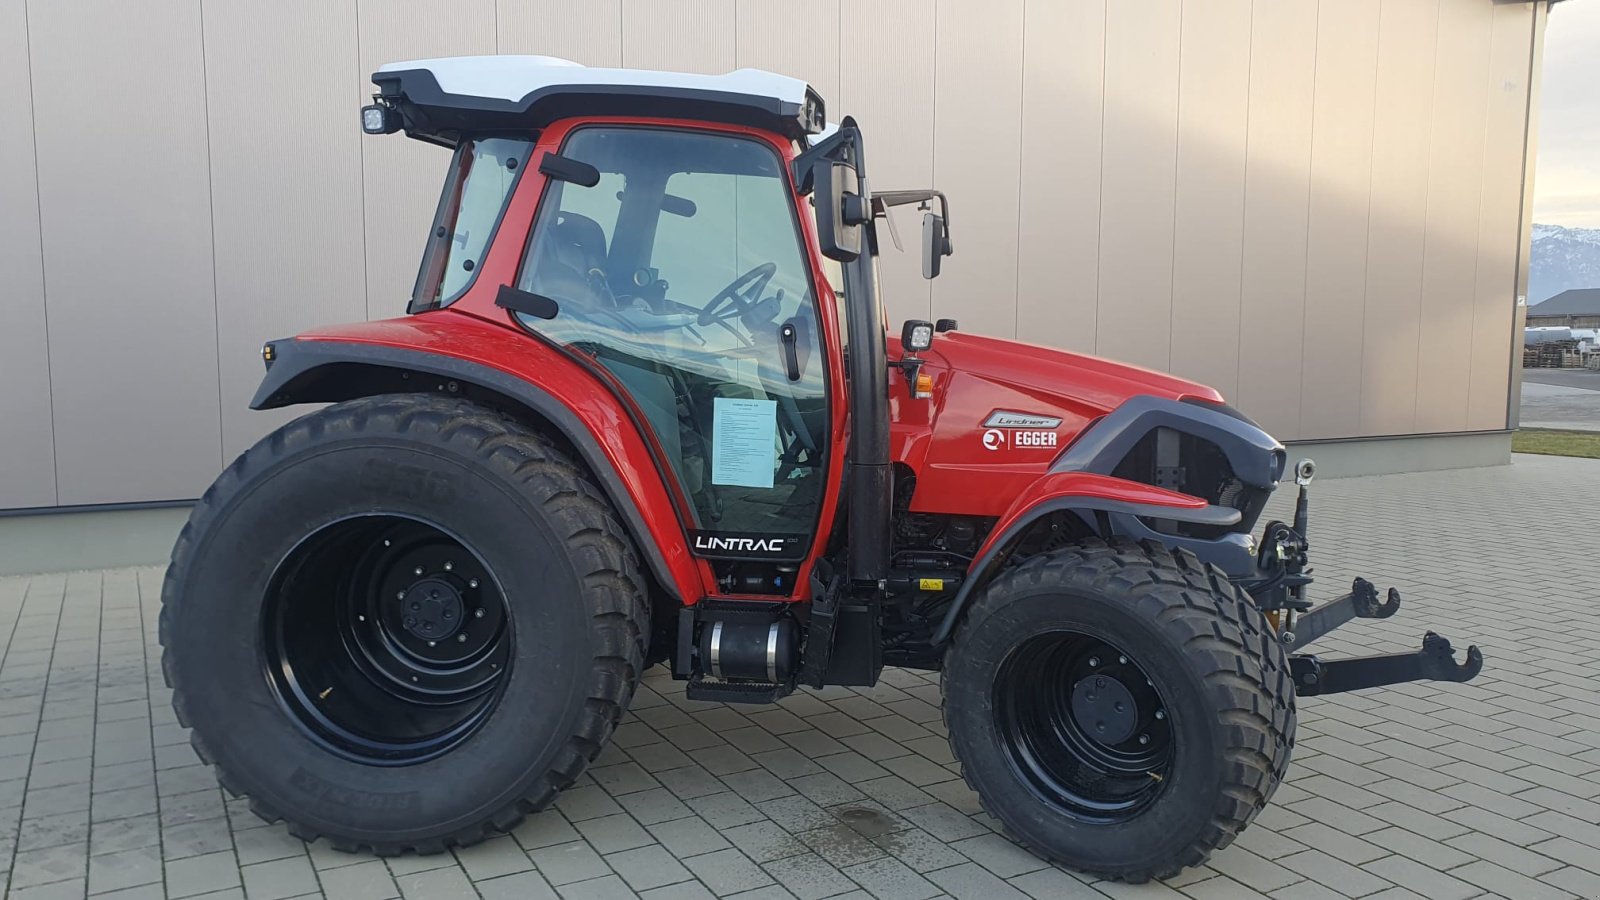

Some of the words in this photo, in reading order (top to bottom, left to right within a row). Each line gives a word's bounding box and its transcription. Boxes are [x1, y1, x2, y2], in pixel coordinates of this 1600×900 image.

[998, 417, 1049, 425] Lindner
[1015, 431, 1057, 446] EGGER
[695, 536, 784, 551] LINTRAC
